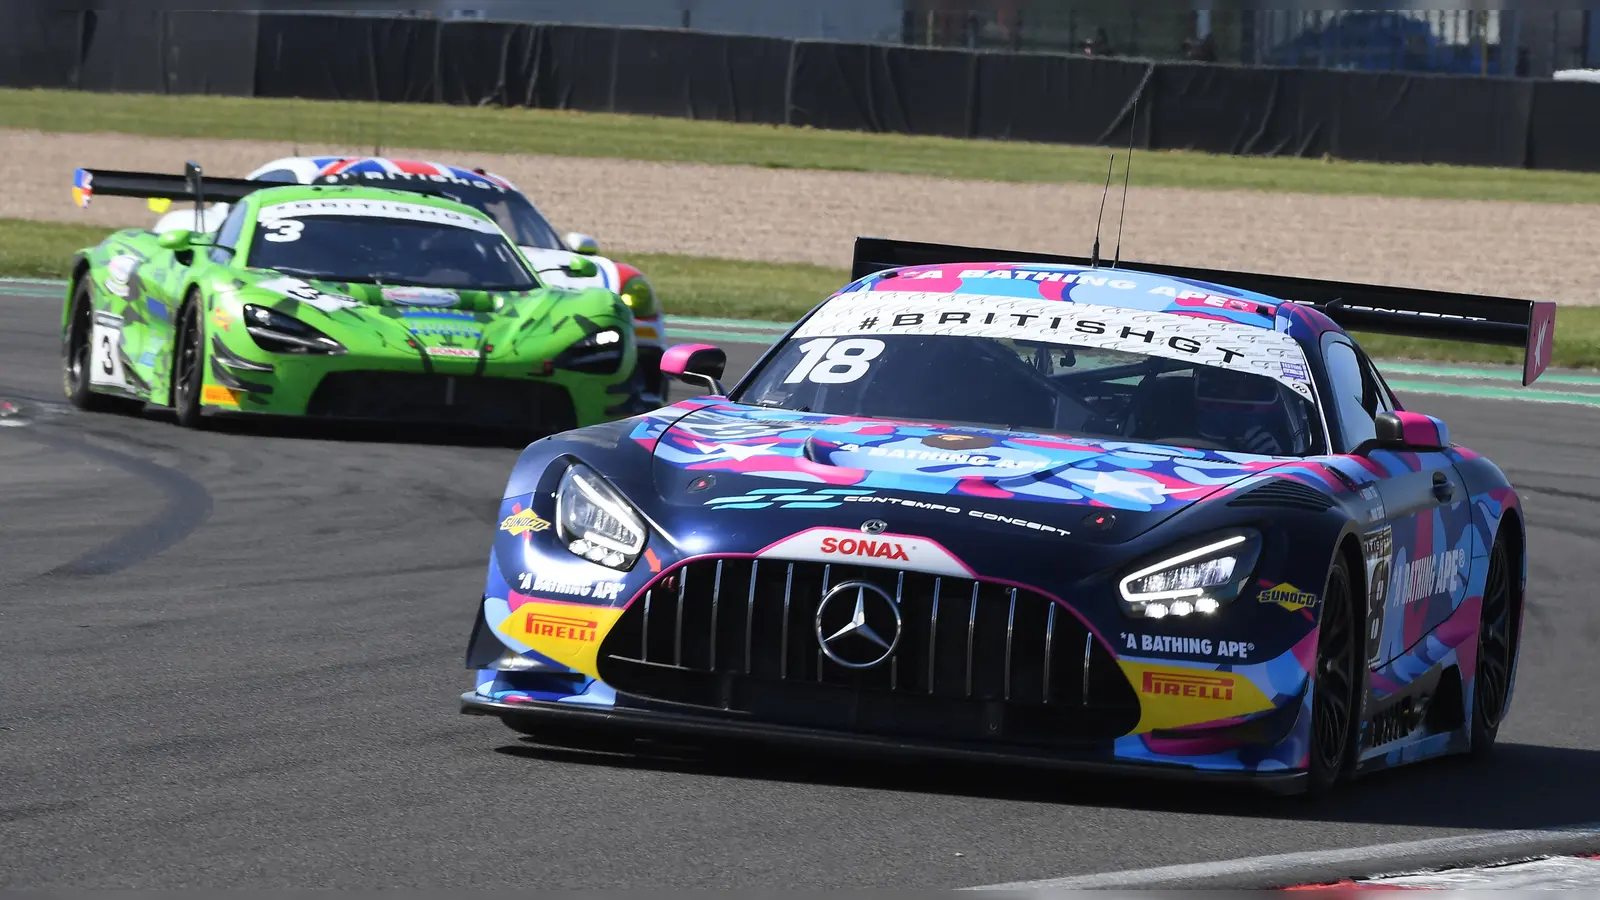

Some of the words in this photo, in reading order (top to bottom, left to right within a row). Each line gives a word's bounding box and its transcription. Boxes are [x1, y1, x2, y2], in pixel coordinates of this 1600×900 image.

[264, 219, 305, 242] 3
[957, 268, 1137, 290] BATHING
[858, 311, 1245, 364] #BRITISHGT
[103, 335, 113, 376] 3
[782, 337, 886, 384] 18
[868, 447, 990, 466] BATHING
[502, 517, 547, 530] SUNOCO
[843, 496, 961, 514] CONTEMPO
[968, 510, 1071, 537] CONCEPT
[821, 537, 910, 561] SONAX
[1402, 555, 1437, 605] BATHING
[1261, 591, 1316, 606] SUNOCO
[526, 613, 597, 642] PIRELLI
[1142, 634, 1213, 655] BATHING
[1142, 671, 1235, 701] PIRELLI
